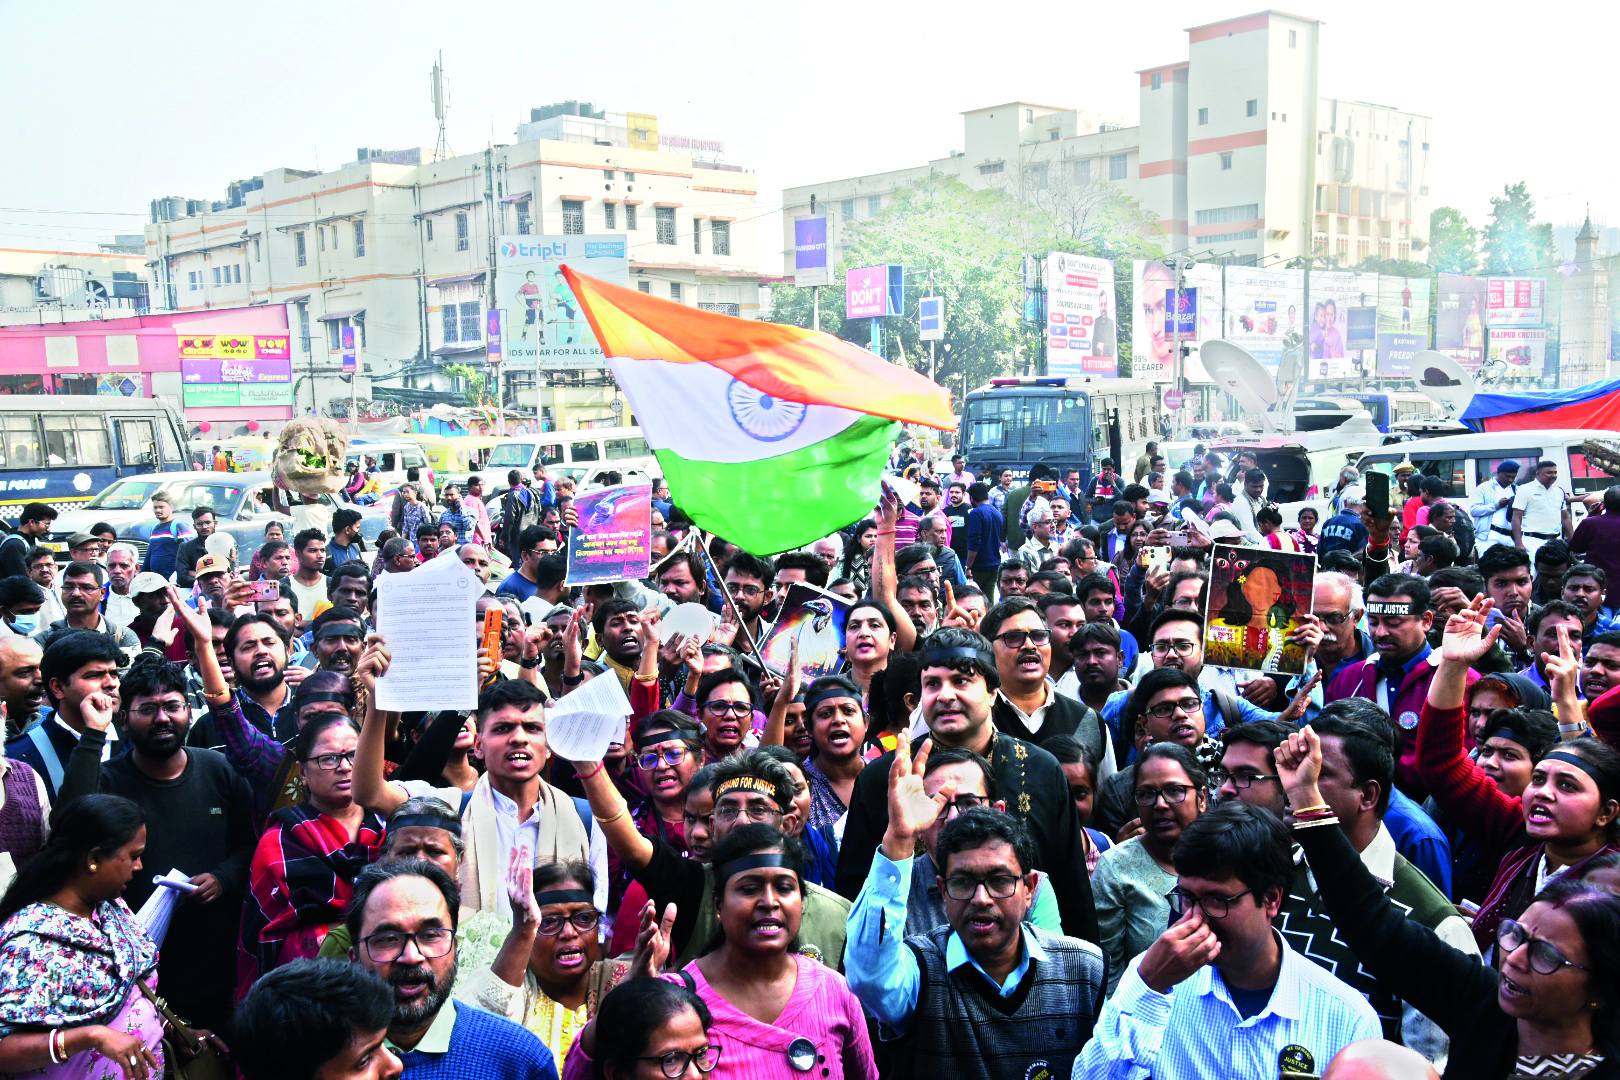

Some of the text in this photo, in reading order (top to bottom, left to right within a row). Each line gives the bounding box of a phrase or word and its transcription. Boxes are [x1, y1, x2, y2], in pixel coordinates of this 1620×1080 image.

[692, 139, 722, 153] HOSPITAL
[519, 241, 567, 260] tripti
[851, 287, 882, 306] DON'T
[868, 304, 880, 313] DRIVE
[1056, 300, 1093, 311] COURSES AVAILABLE
[1491, 331, 1545, 339] RAIPUR CRUISER
[220, 338, 251, 348] WOW!
[257, 338, 287, 349] WOW!
[553, 348, 570, 357] FOR
[572, 348, 588, 356] ALL
[1133, 355, 1148, 363] 95%
[1133, 363, 1164, 371] CLEARER
[258, 373, 289, 382] Express
[186, 385, 195, 393] La
[8, 478, 47, 491] POLICE
[1322, 525, 1354, 541] NIKE
[1369, 602, 1383, 614] WANT
[1383, 604, 1409, 615] JUSTICE
[719, 777, 740, 794] DEMAND
[740, 776, 753, 789] FOR
[753, 778, 776, 797] JUSTICE
[1295, 1046, 1312, 1060] DEMAND
[1027, 1062, 1048, 1073] DEMAND
[1284, 1056, 1309, 1070] JUSTICE
